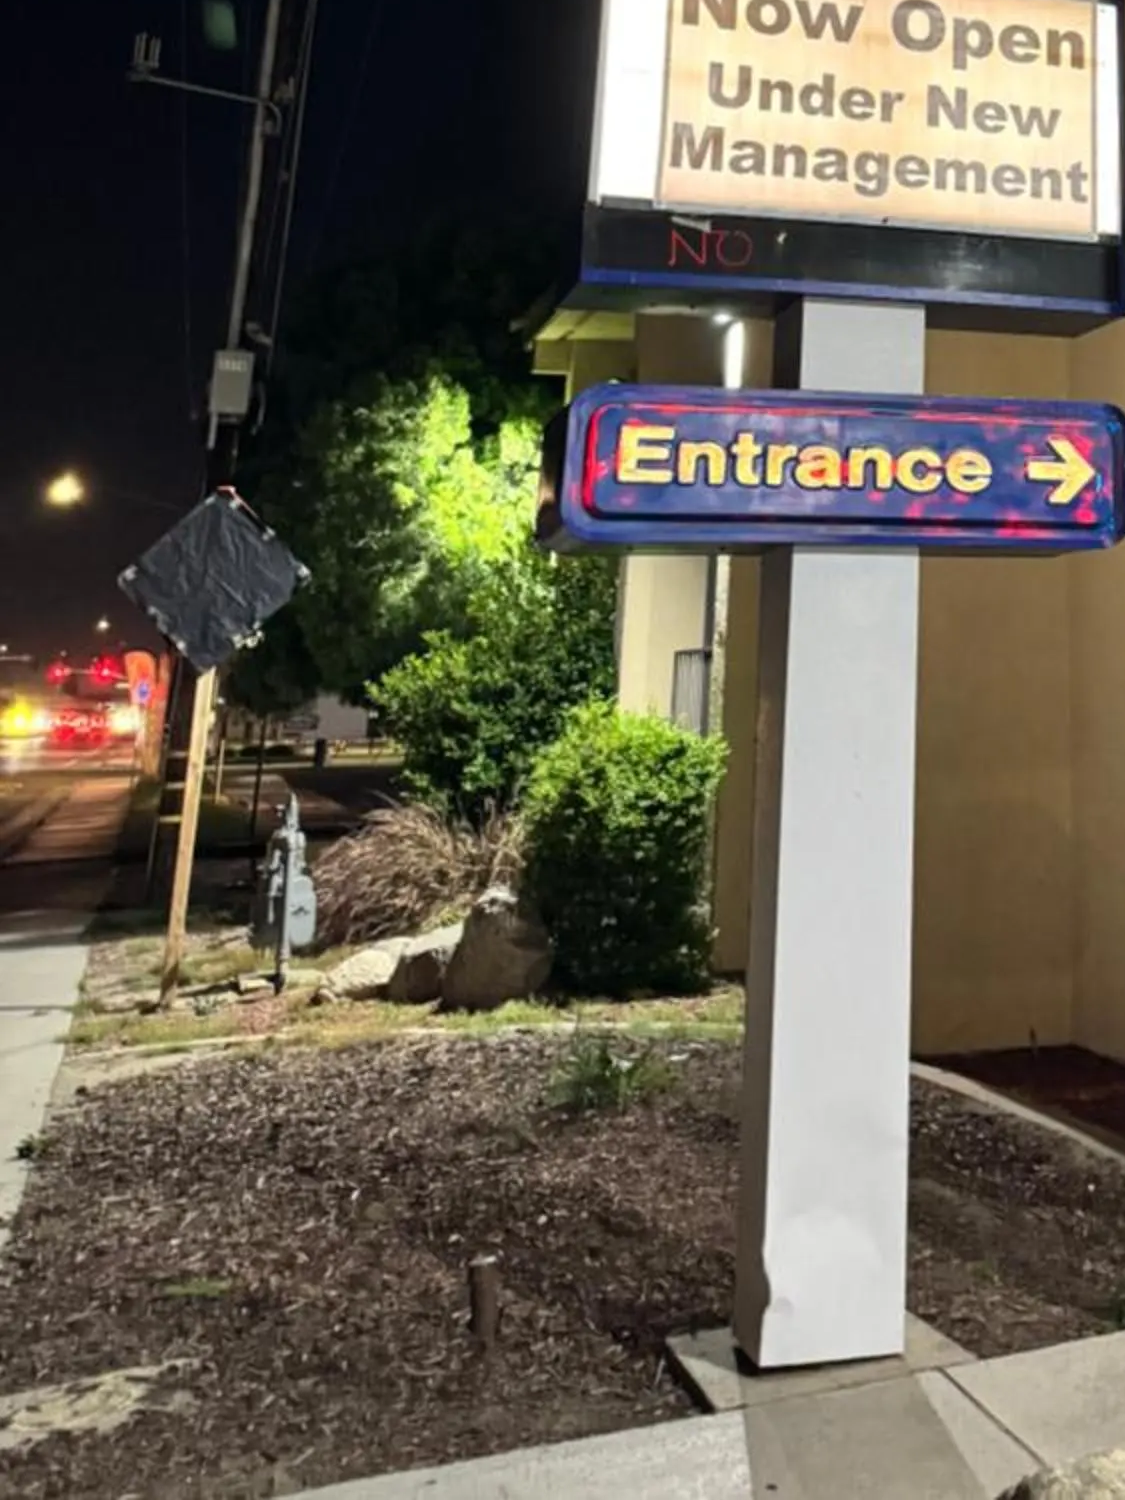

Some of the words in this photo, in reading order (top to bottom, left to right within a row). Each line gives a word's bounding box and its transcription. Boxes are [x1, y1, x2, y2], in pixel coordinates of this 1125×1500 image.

[706, 62, 904, 123] Under
[925, 84, 1062, 139] New
[668, 121, 1089, 203] Management
[668, 229, 753, 268] NO
[615, 424, 994, 492] Entrance
